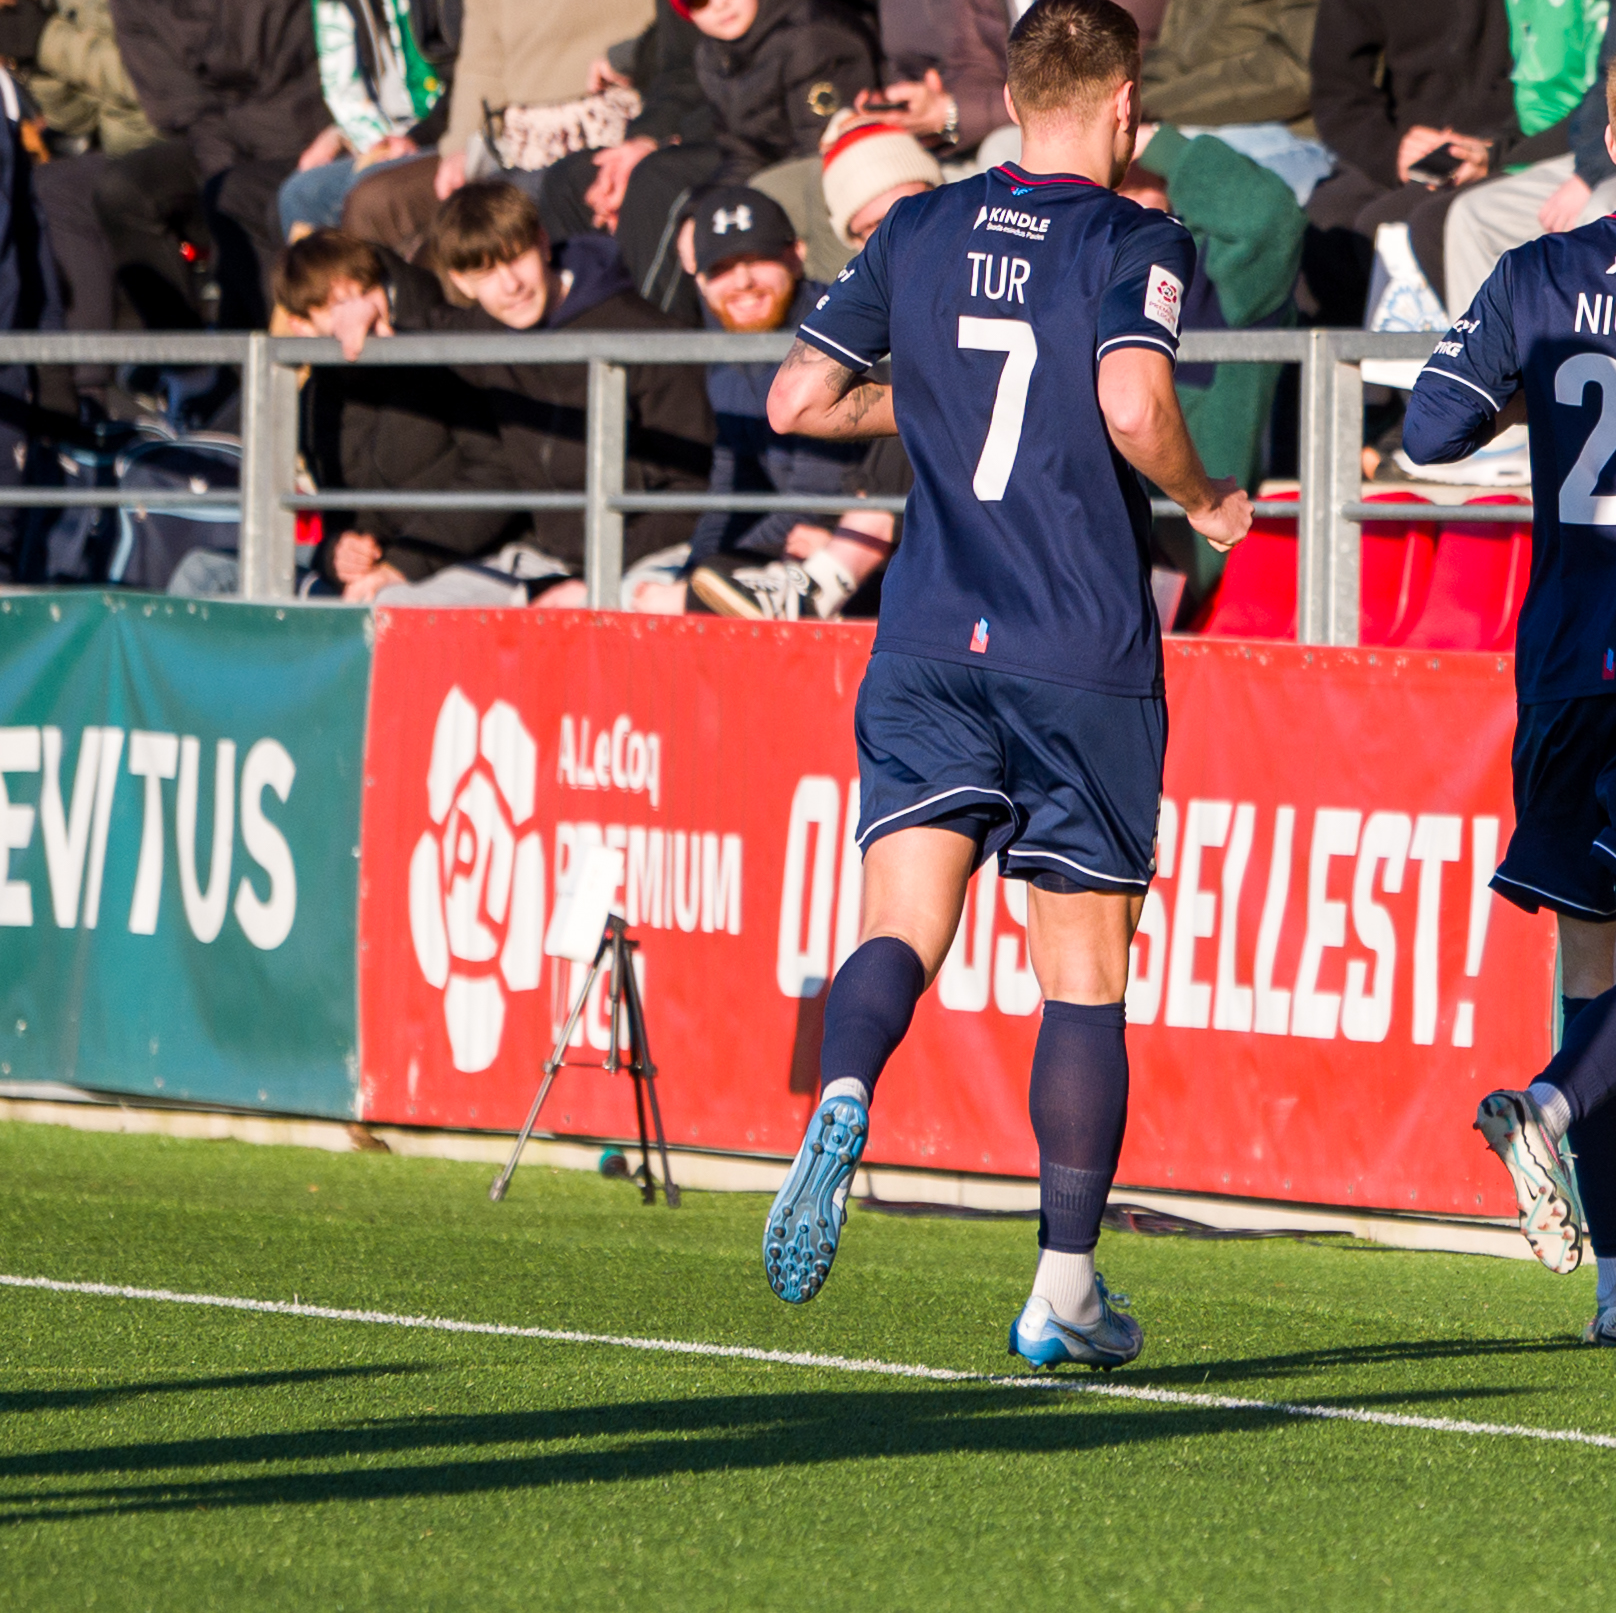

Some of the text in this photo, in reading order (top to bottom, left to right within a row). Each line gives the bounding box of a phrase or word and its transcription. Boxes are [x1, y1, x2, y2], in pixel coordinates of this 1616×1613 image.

[988, 207, 1051, 234] KINDLE
[967, 251, 1032, 305] TUR
[957, 315, 1038, 502] 7
[553, 821, 743, 935] PEMIUM
